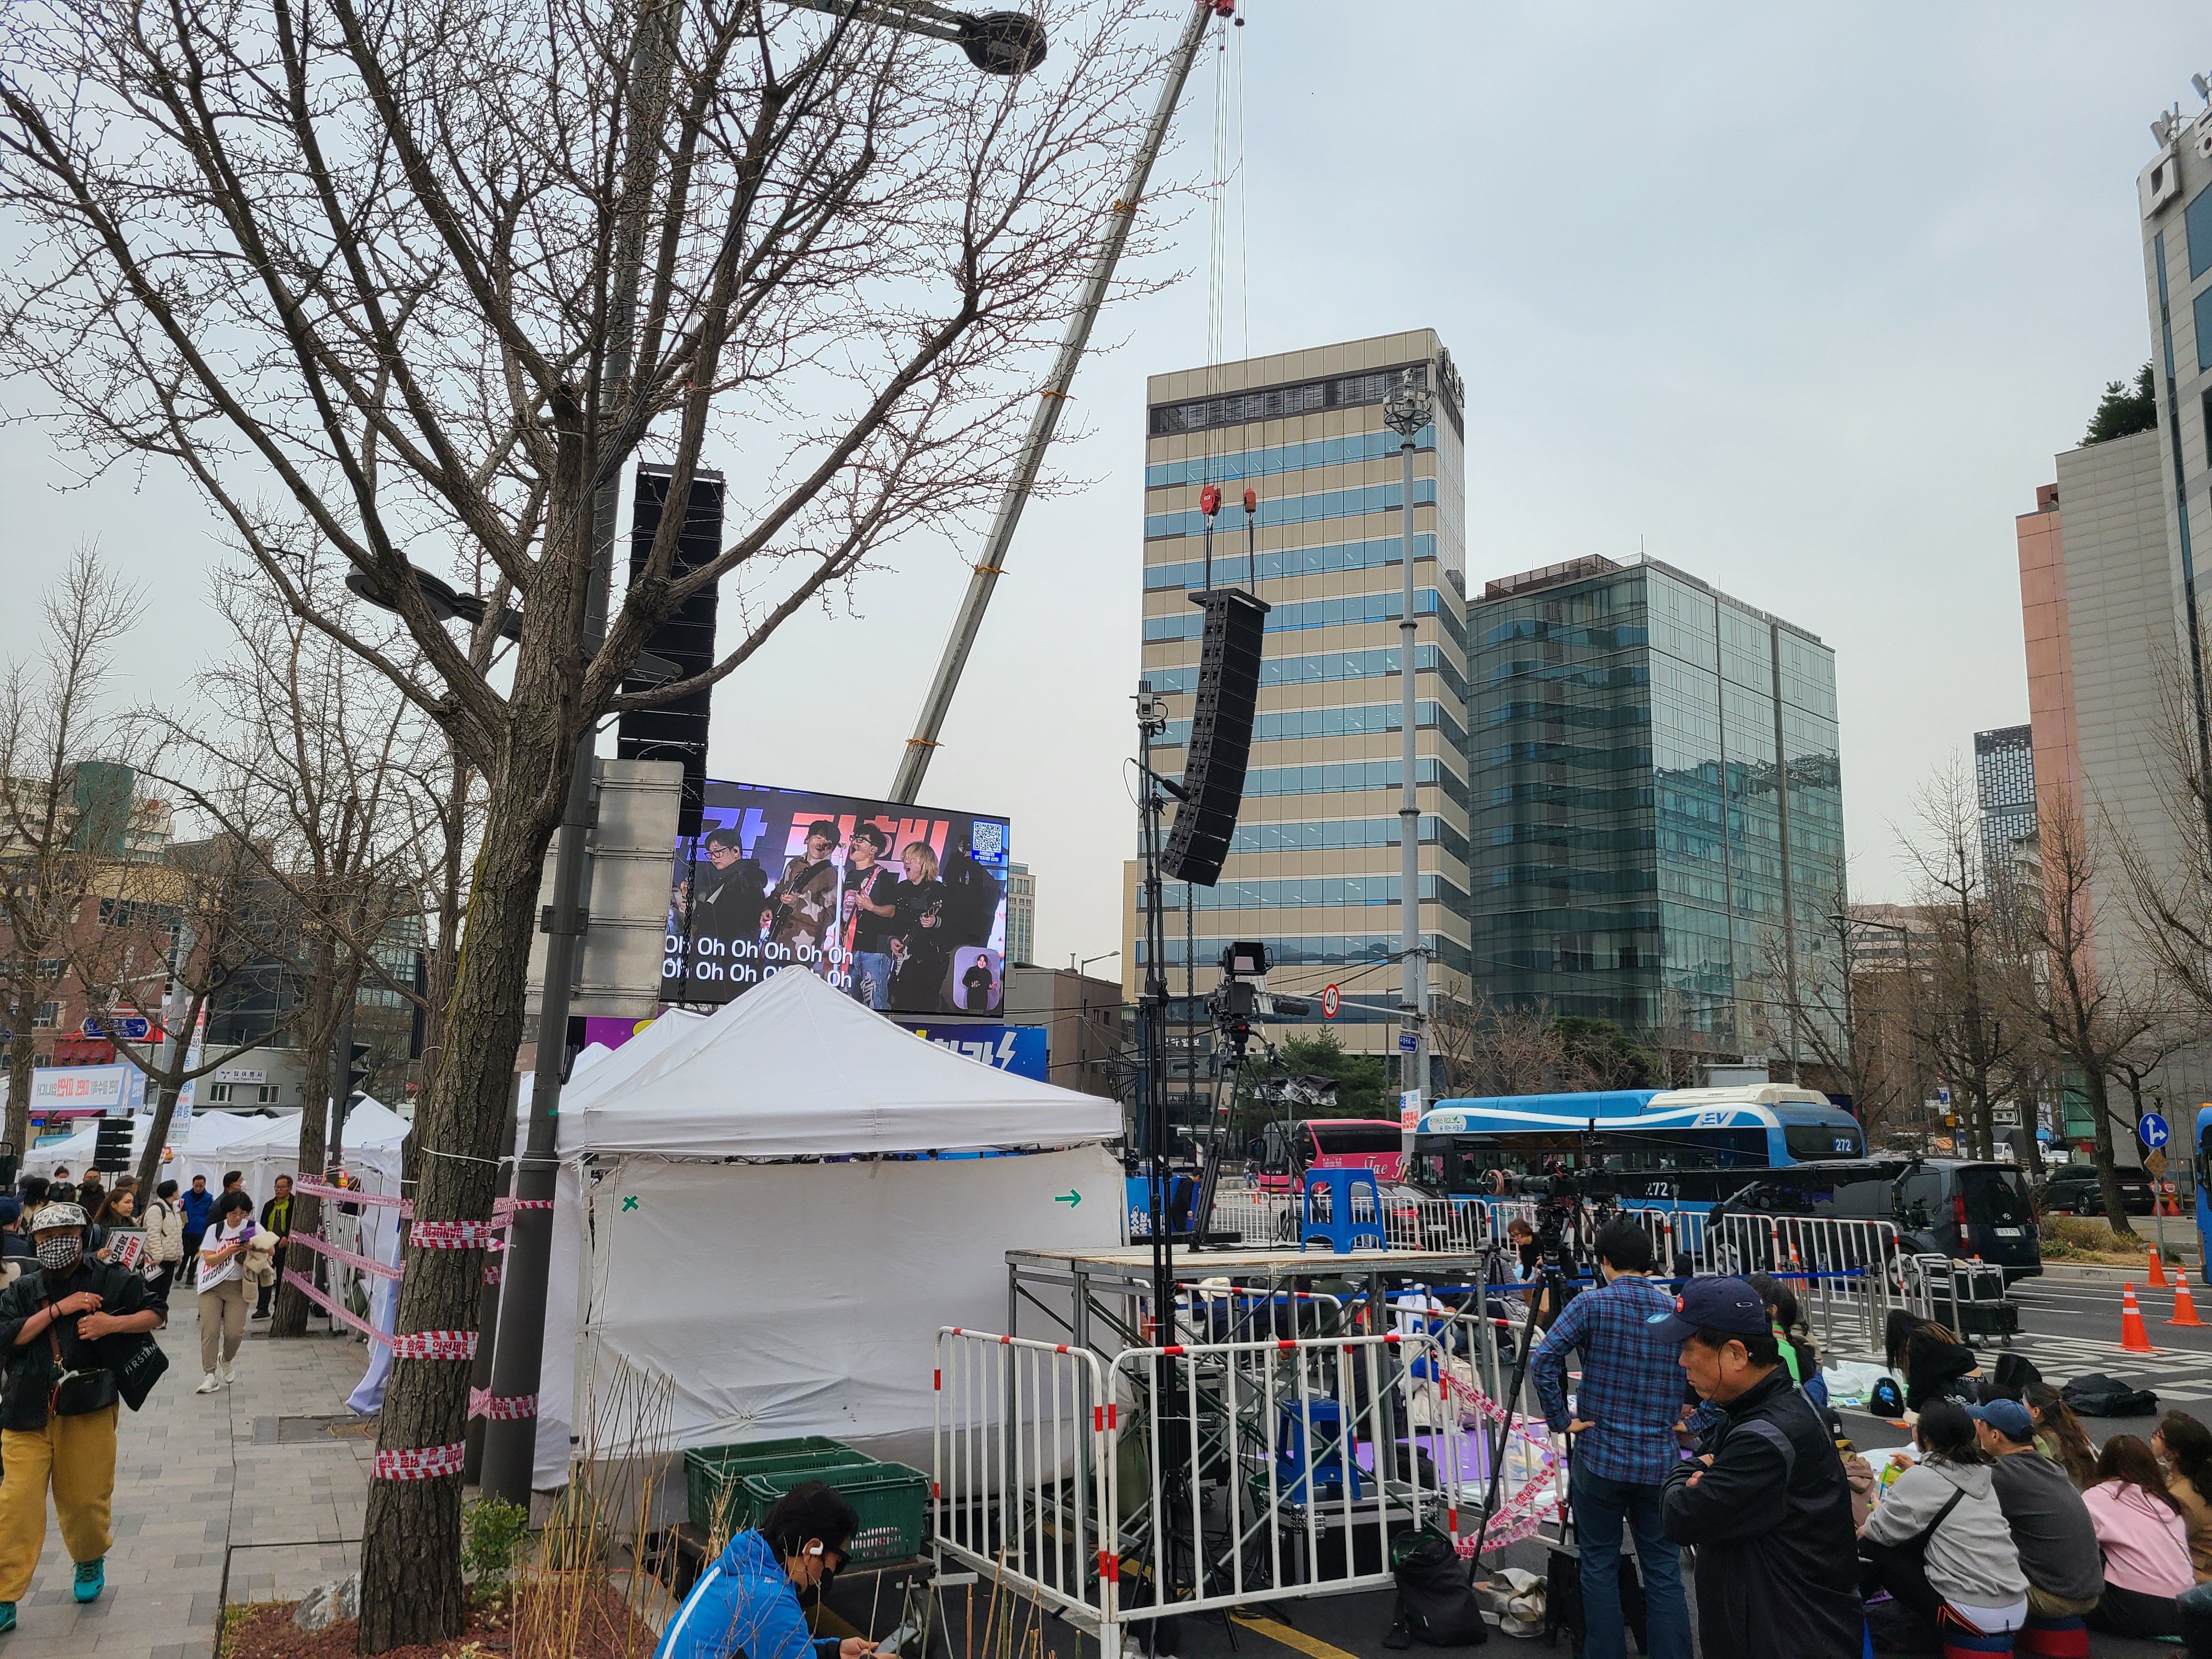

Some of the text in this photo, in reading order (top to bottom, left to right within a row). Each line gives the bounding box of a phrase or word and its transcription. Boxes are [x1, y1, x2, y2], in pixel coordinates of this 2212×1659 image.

[698, 937, 725, 956] Oh
[732, 939, 758, 958] Oh
[765, 942, 791, 961] Oh
[797, 944, 822, 963] Oh
[829, 947, 853, 965] Oh
[696, 961, 724, 980] Oh
[730, 963, 757, 983] Oh
[827, 970, 852, 988] Oh
[1326, 991, 1336, 1010] 40
[1703, 1112, 1729, 1125] EV
[1835, 1138, 1851, 1152] 272
[422, 1226, 464, 1239] DANGER!
[432, 1340, 469, 1353] 안전제일
